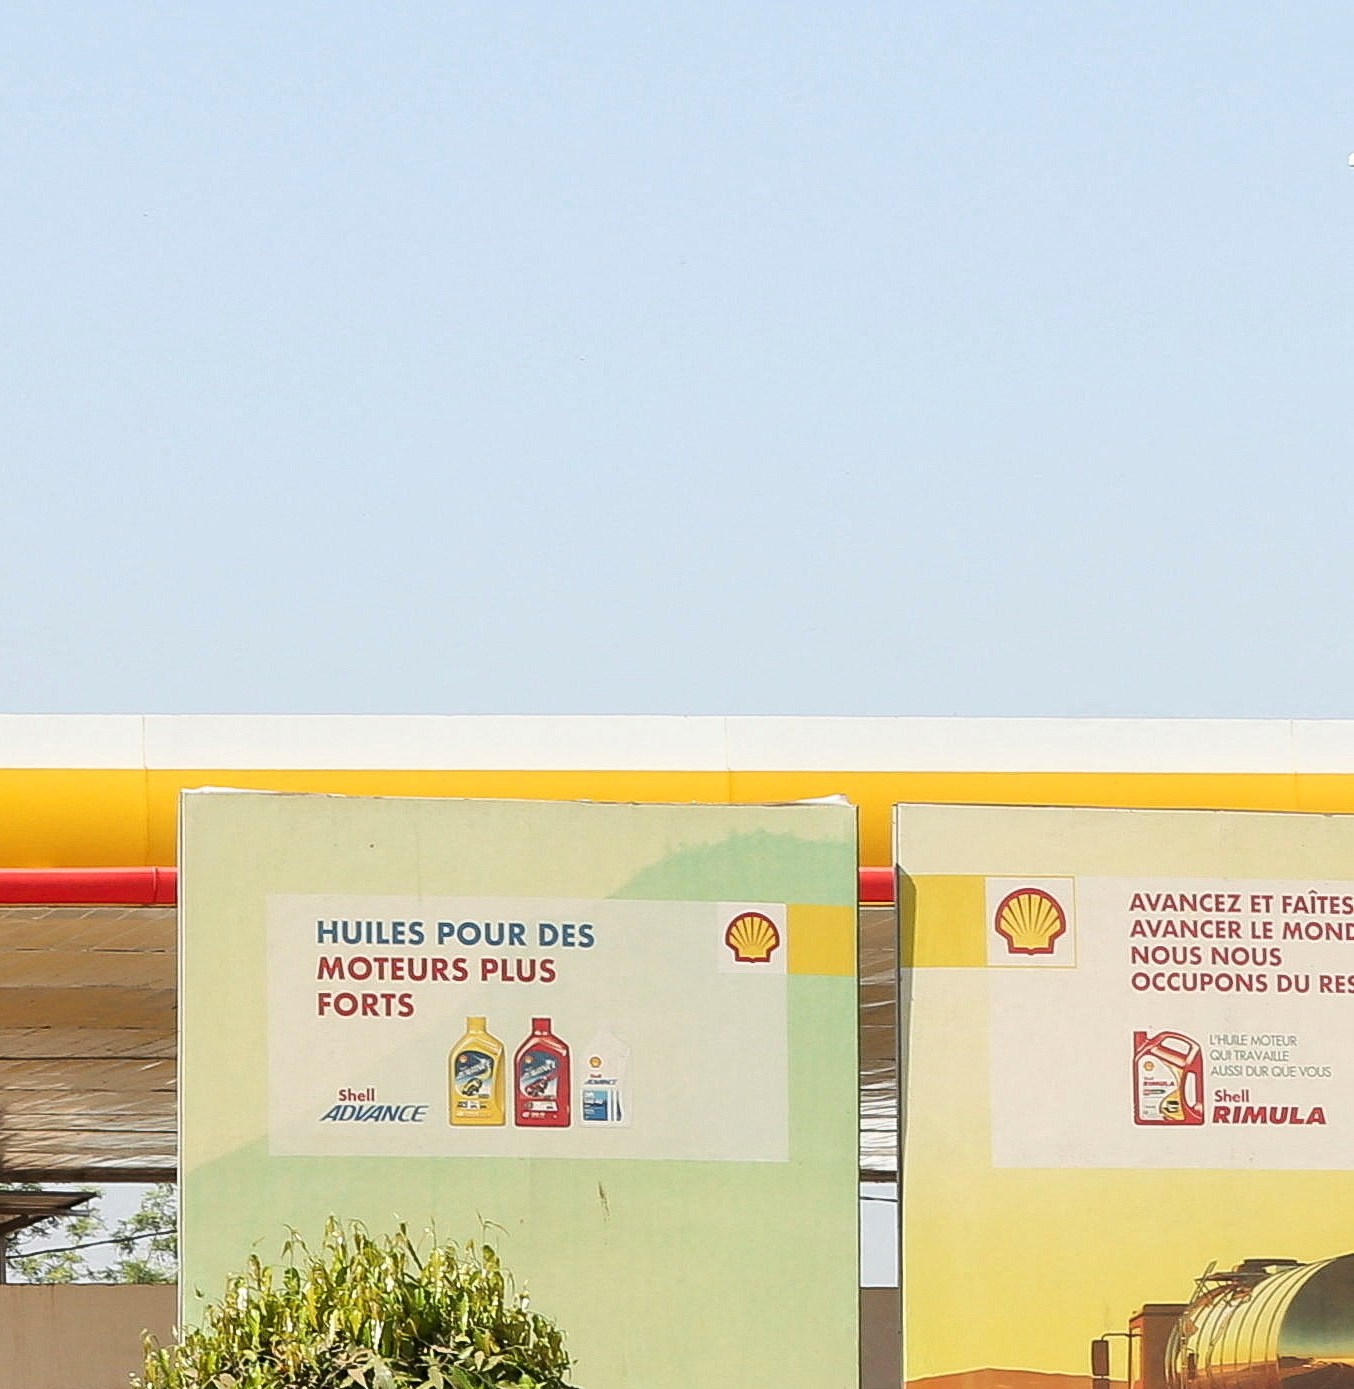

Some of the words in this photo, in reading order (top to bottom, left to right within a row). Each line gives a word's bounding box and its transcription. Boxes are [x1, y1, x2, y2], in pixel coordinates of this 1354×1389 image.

[1129, 893, 1242, 912] AVANCEZ
[1250, 895, 1273, 913] ET
[1282, 889, 1354, 915] FAÎTES
[317, 920, 425, 944] HUILES
[437, 922, 527, 946] POUR
[538, 923, 595, 948] DES
[1129, 920, 1243, 938] AVANCER
[1251, 921, 1273, 939] LE
[1131, 946, 1202, 965] NOUS
[1211, 947, 1282, 966] NOUS
[317, 956, 468, 981] MOTEURS
[481, 958, 556, 982] PLUS
[1131, 972, 1268, 992] OCCUPONS
[1277, 974, 1310, 993] DU
[317, 992, 414, 1017] FORTS
[1250, 1035, 1297, 1047] MOTEUR
[1209, 1049, 1232, 1061] QUI
[1235, 1050, 1289, 1061] TRAVAILLE
[1211, 1065, 1242, 1077] AUSSI
[1245, 1066, 1267, 1077] DUR
[1271, 1066, 1297, 1078] QUE
[1298, 1066, 1332, 1077] VOUS
[338, 1088, 375, 1102] Shell
[1214, 1089, 1250, 1103] Shell
[319, 1105, 429, 1122] ADVANCE
[1212, 1106, 1327, 1125] RIMULA
